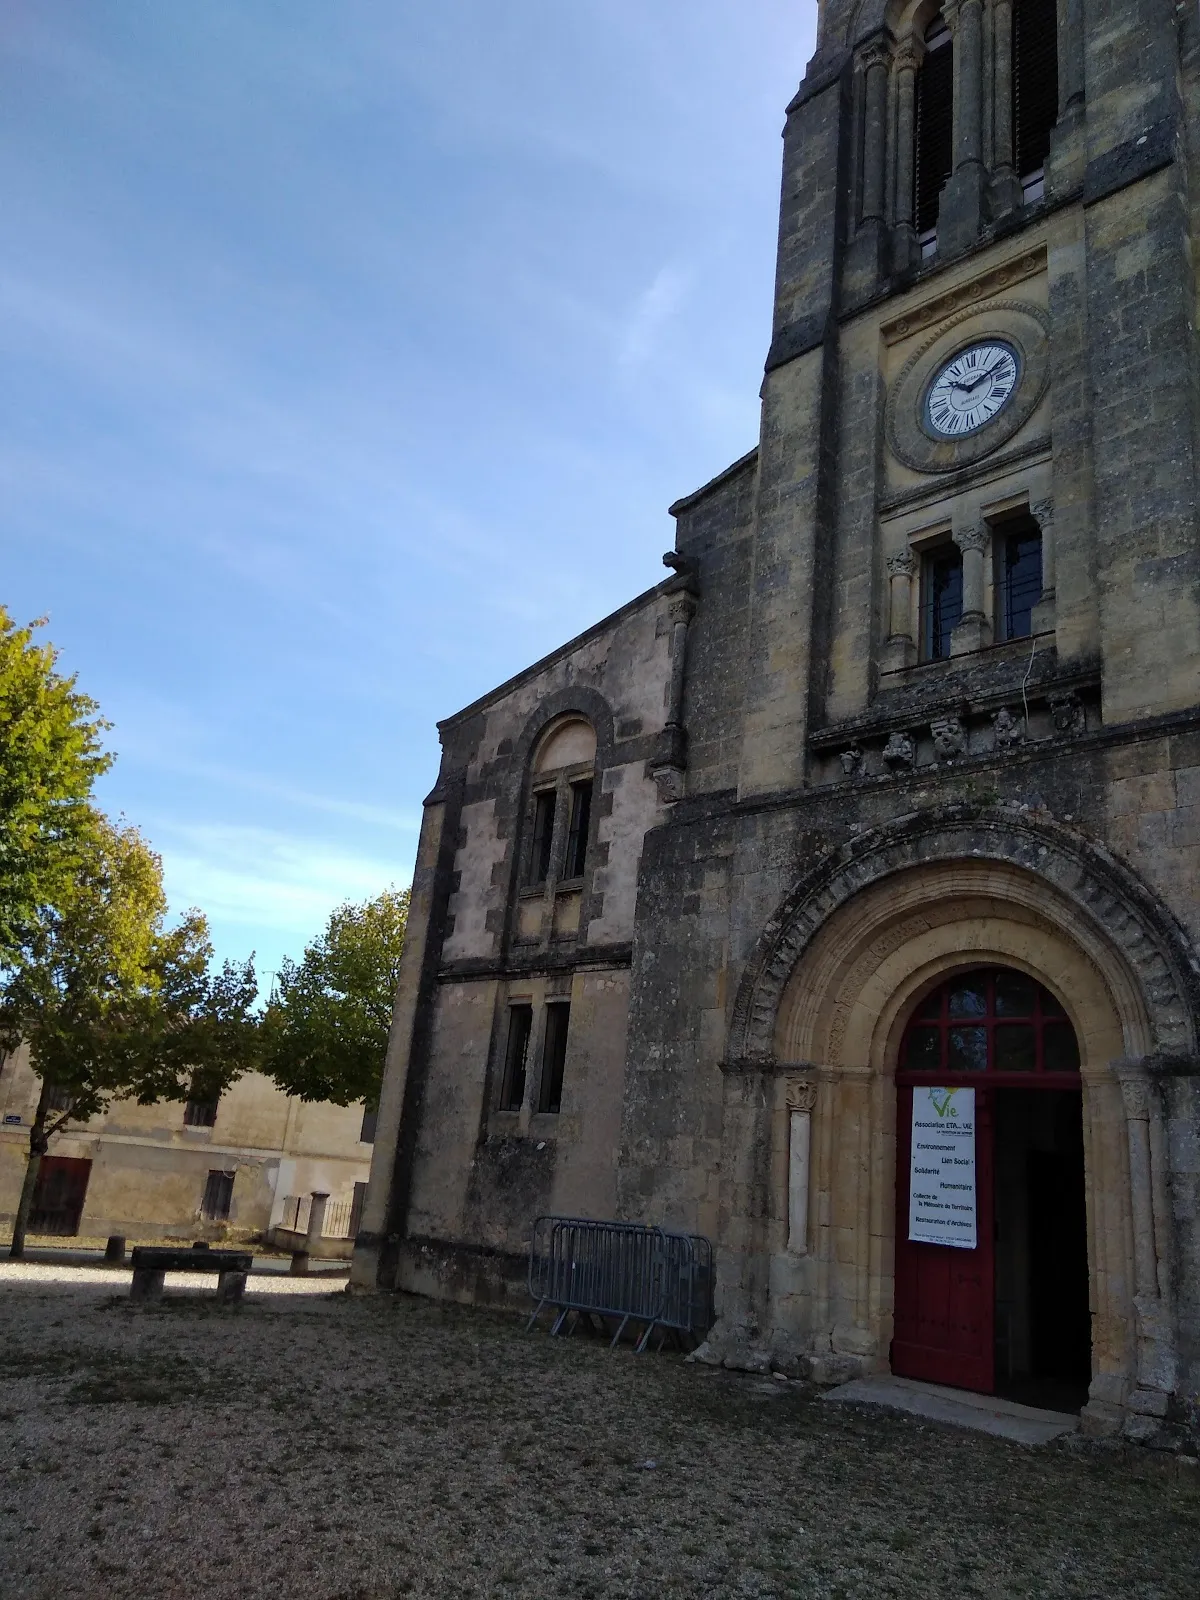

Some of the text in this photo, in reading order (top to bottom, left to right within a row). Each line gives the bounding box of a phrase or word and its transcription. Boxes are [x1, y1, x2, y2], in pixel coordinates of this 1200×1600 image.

[932, 1094, 959, 1117] Vie
[914, 1121, 945, 1129] Association
[916, 1143, 956, 1151] Environnement
[914, 1167, 940, 1175] Solidarité
[939, 1182, 972, 1191] Humanitaire
[915, 1216, 972, 1228] Restauration d'Archives
